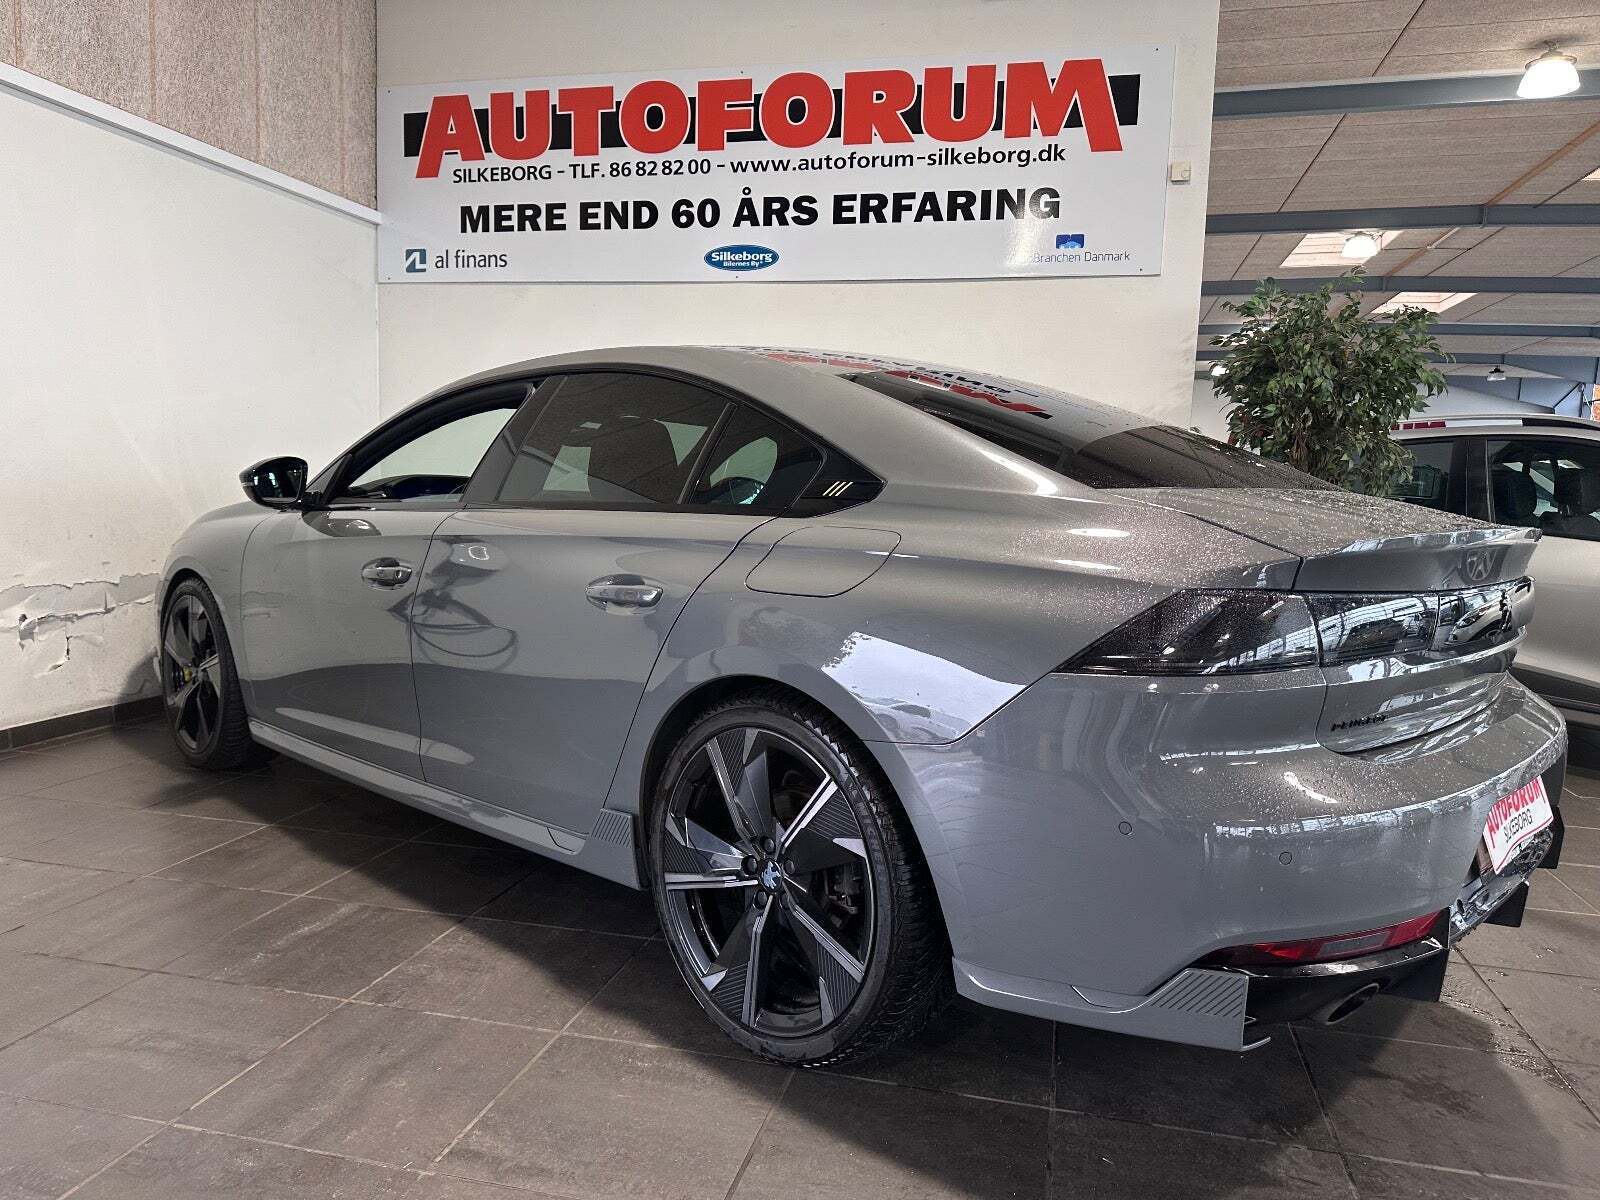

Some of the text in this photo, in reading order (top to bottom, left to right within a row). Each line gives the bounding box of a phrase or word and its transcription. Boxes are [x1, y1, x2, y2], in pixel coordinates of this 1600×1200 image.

[415, 58, 1123, 178] AUTOFORUM
[453, 165, 551, 183] SILKEBORG
[569, 163, 605, 179] TLF.
[731, 144, 1066, 174] www.autoforum-silkeborg.dk
[460, 187, 1061, 234] MERE END 60 ÅRS ERFARING
[435, 249, 508, 269] al finans
[711, 251, 773, 263] Silkeborg
[1084, 251, 1131, 262] Danmark
[1485, 777, 1546, 849] AUTOFORUM
